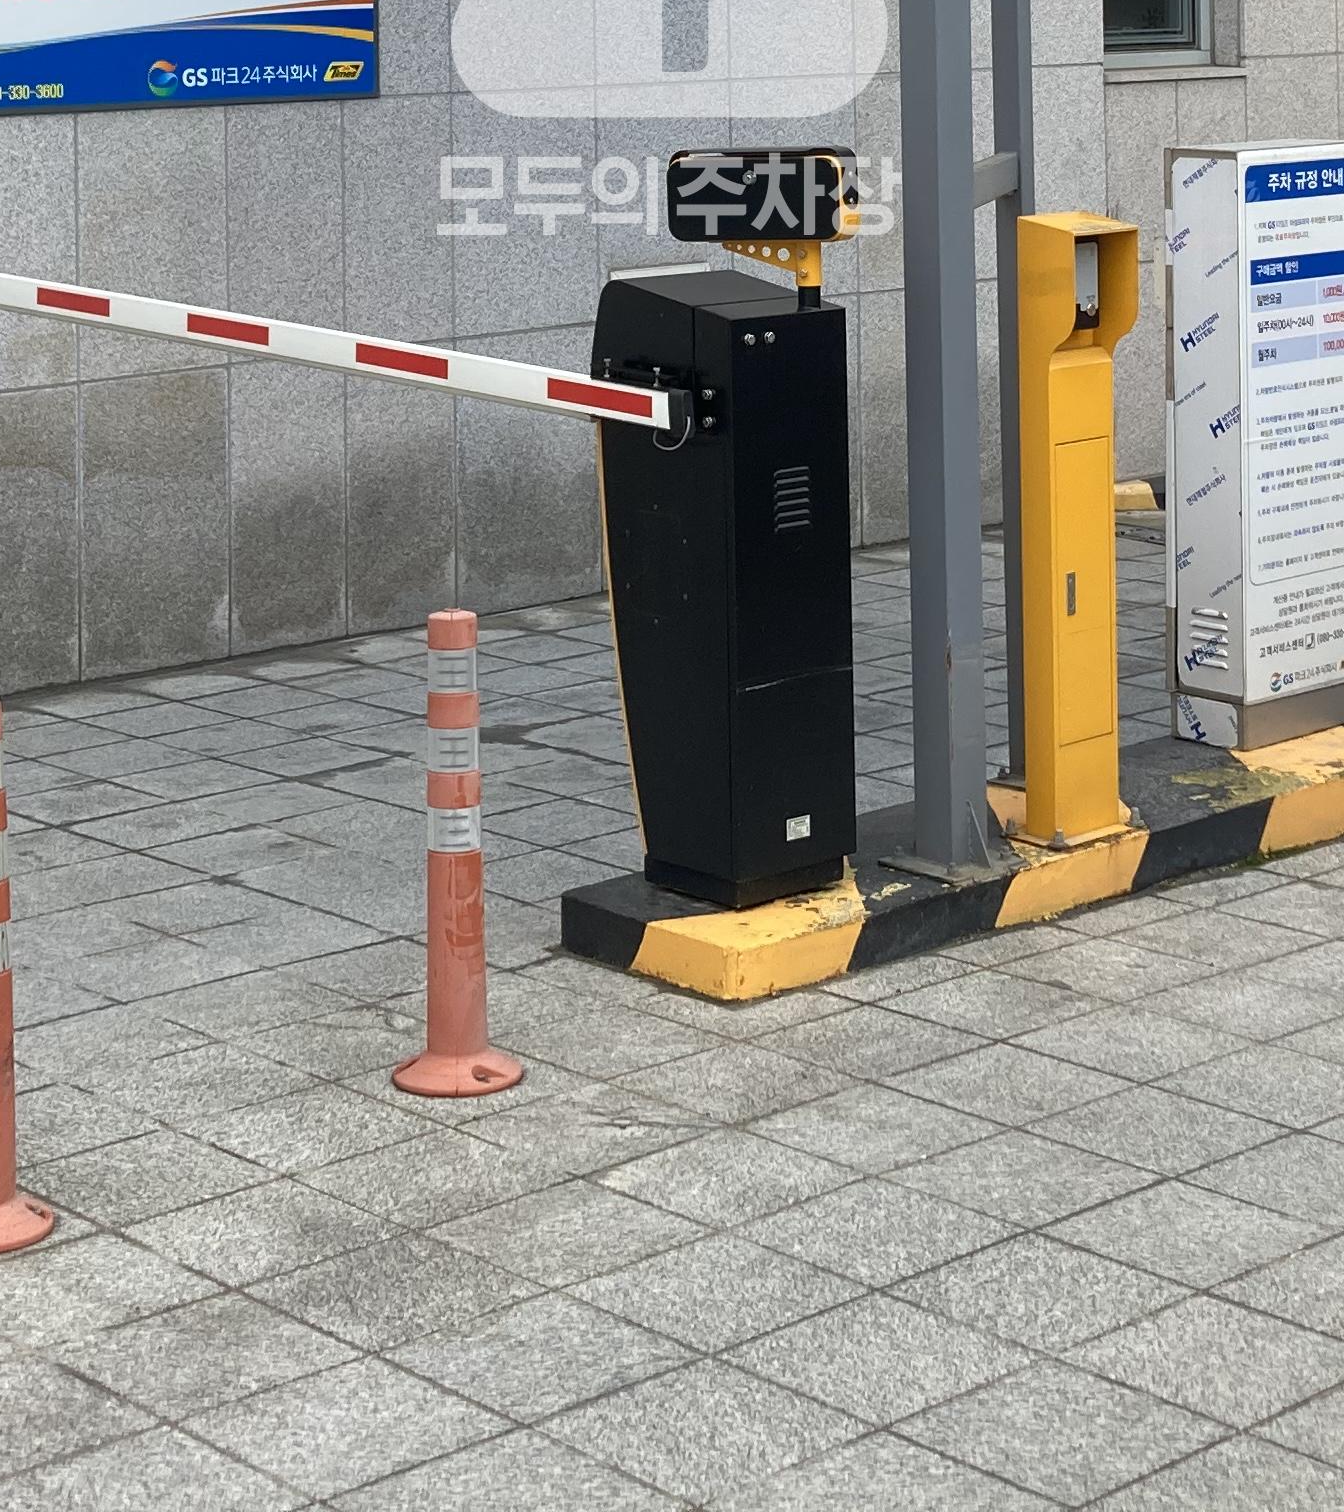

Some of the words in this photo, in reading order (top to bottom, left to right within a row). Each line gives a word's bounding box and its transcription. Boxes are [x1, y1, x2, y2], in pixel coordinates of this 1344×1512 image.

[182, 67, 208, 87] GS
[1268, 172, 1291, 192] 주차
[1295, 169, 1317, 190] 규정
[1321, 167, 1344, 187] 안내
[1256, 292, 1282, 307] 일반요금
[1195, 326, 1216, 344] STEEL
[1259, 637, 1304, 659] 고객서비스센터
[1283, 673, 1295, 685] GS
